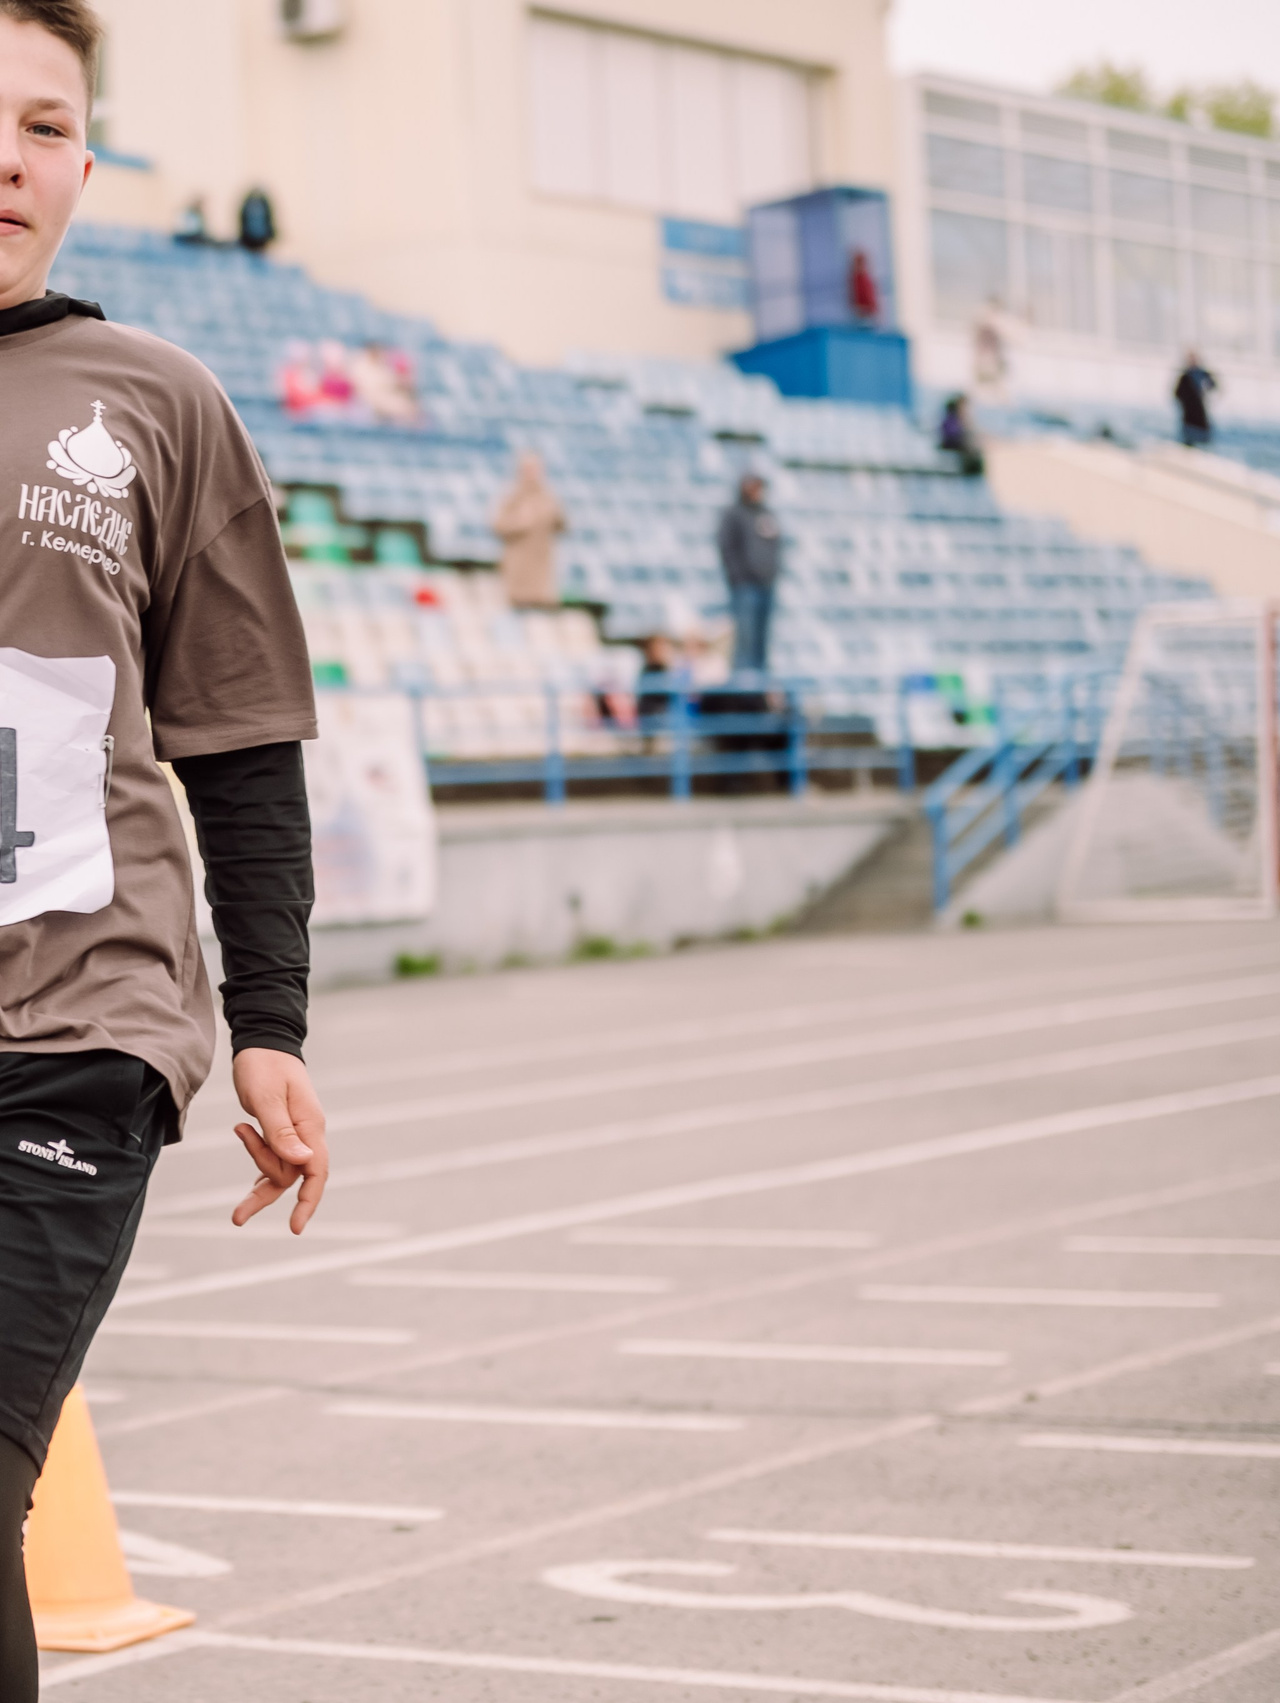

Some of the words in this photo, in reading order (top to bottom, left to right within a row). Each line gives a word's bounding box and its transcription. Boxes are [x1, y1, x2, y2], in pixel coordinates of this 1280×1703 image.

[21, 531, 36, 546] г.
[18, 1140, 56, 1162] STONE
[58, 1155, 98, 1176] ISLAND
